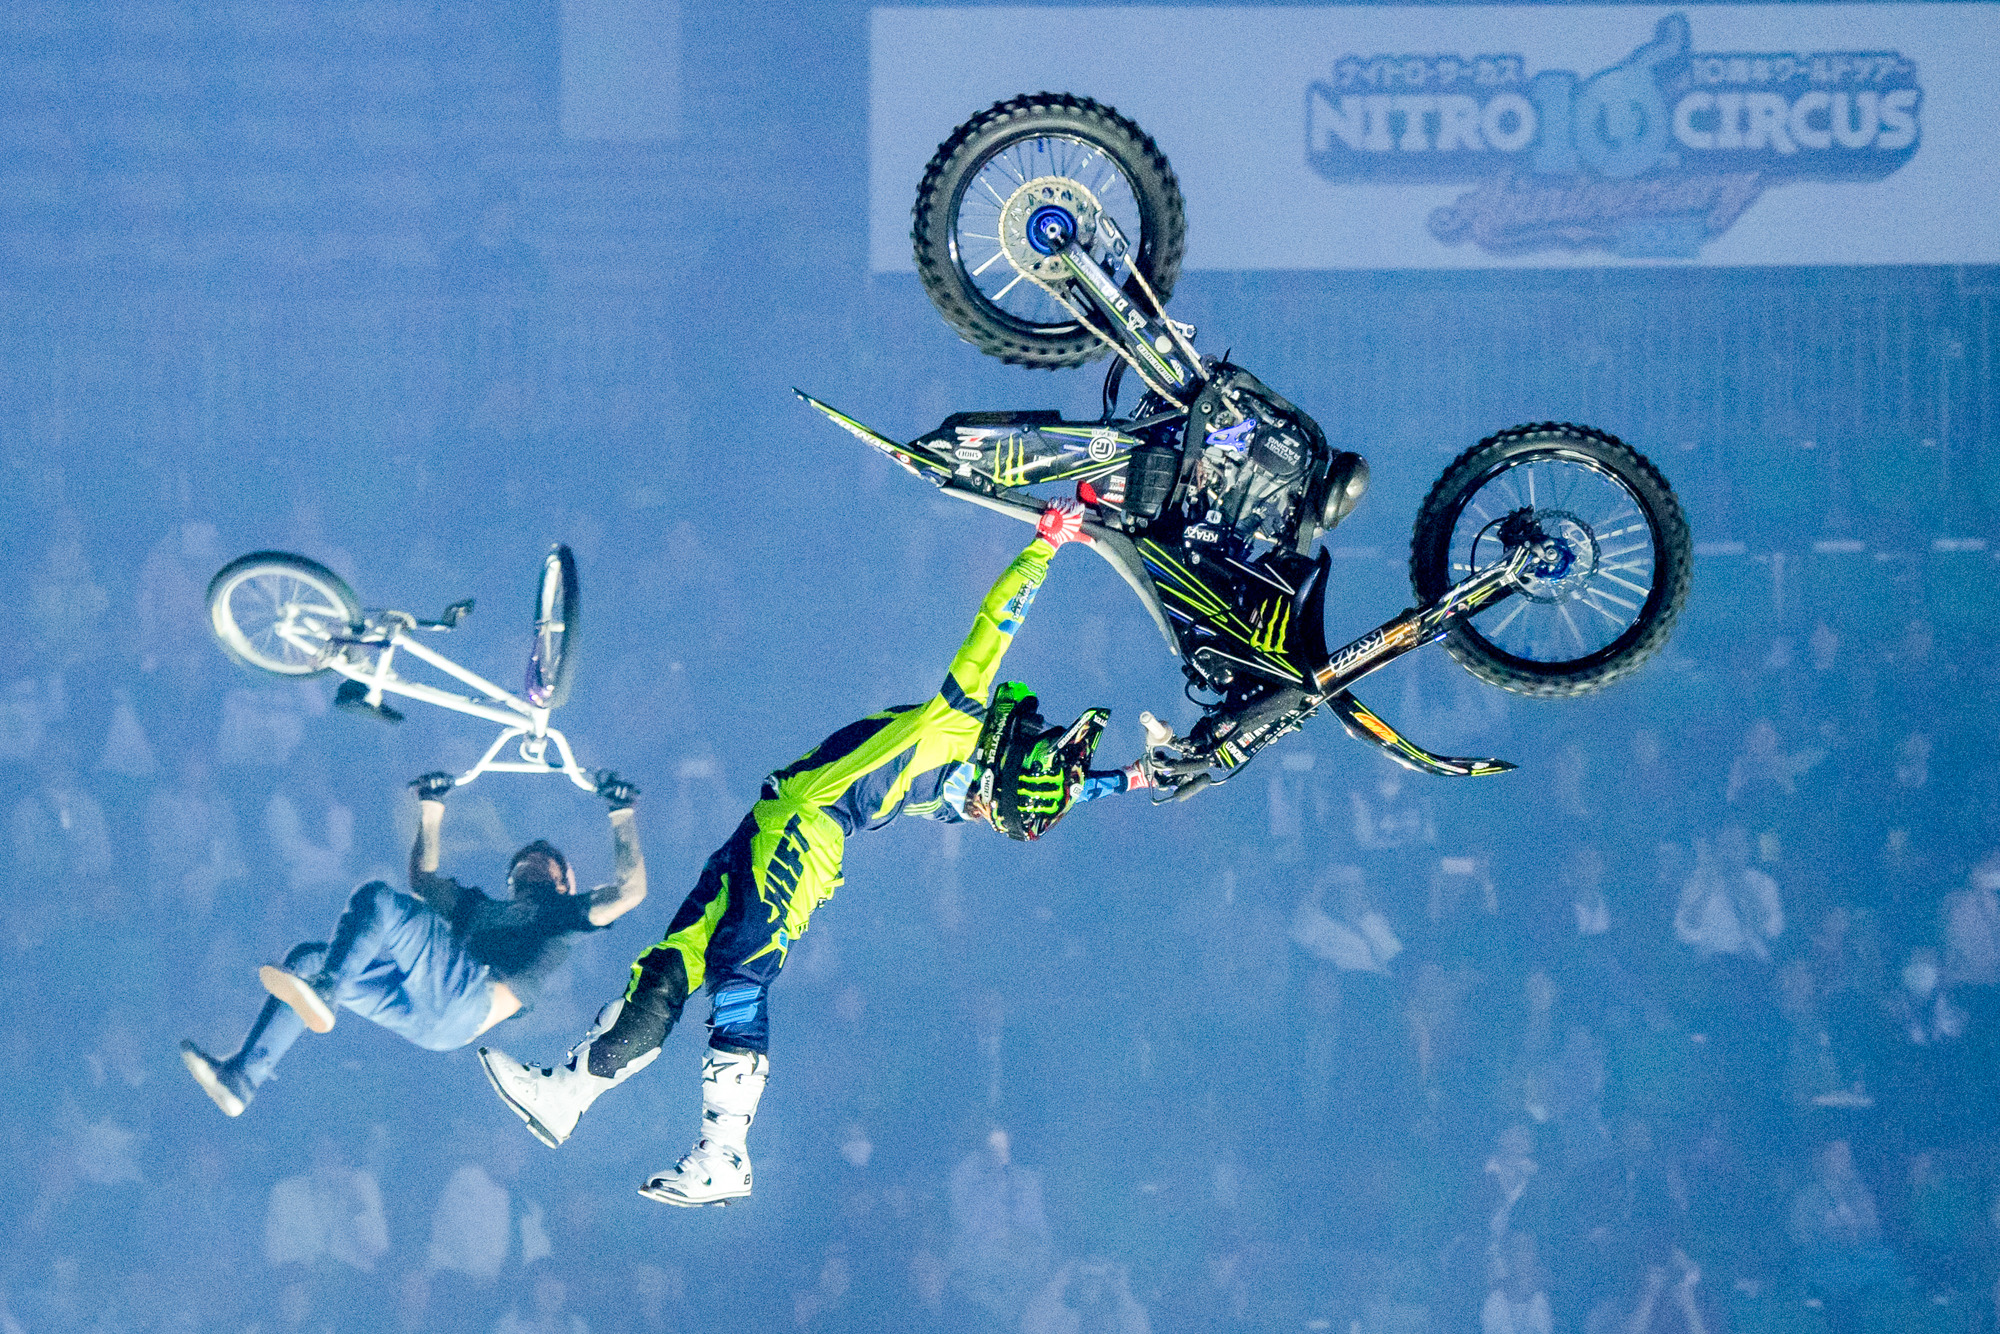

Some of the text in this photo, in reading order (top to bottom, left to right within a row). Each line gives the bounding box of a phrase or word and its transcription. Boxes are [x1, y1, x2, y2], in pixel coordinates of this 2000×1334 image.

[1312, 93, 1538, 152] NITRO
[1672, 91, 1920, 154] CIRCUS
[1264, 436, 1298, 465] FACTORY
[1268, 434, 1301, 459] RACING
[986, 711, 1011, 764] MONSTER
[763, 812, 811, 932] SHIFT
